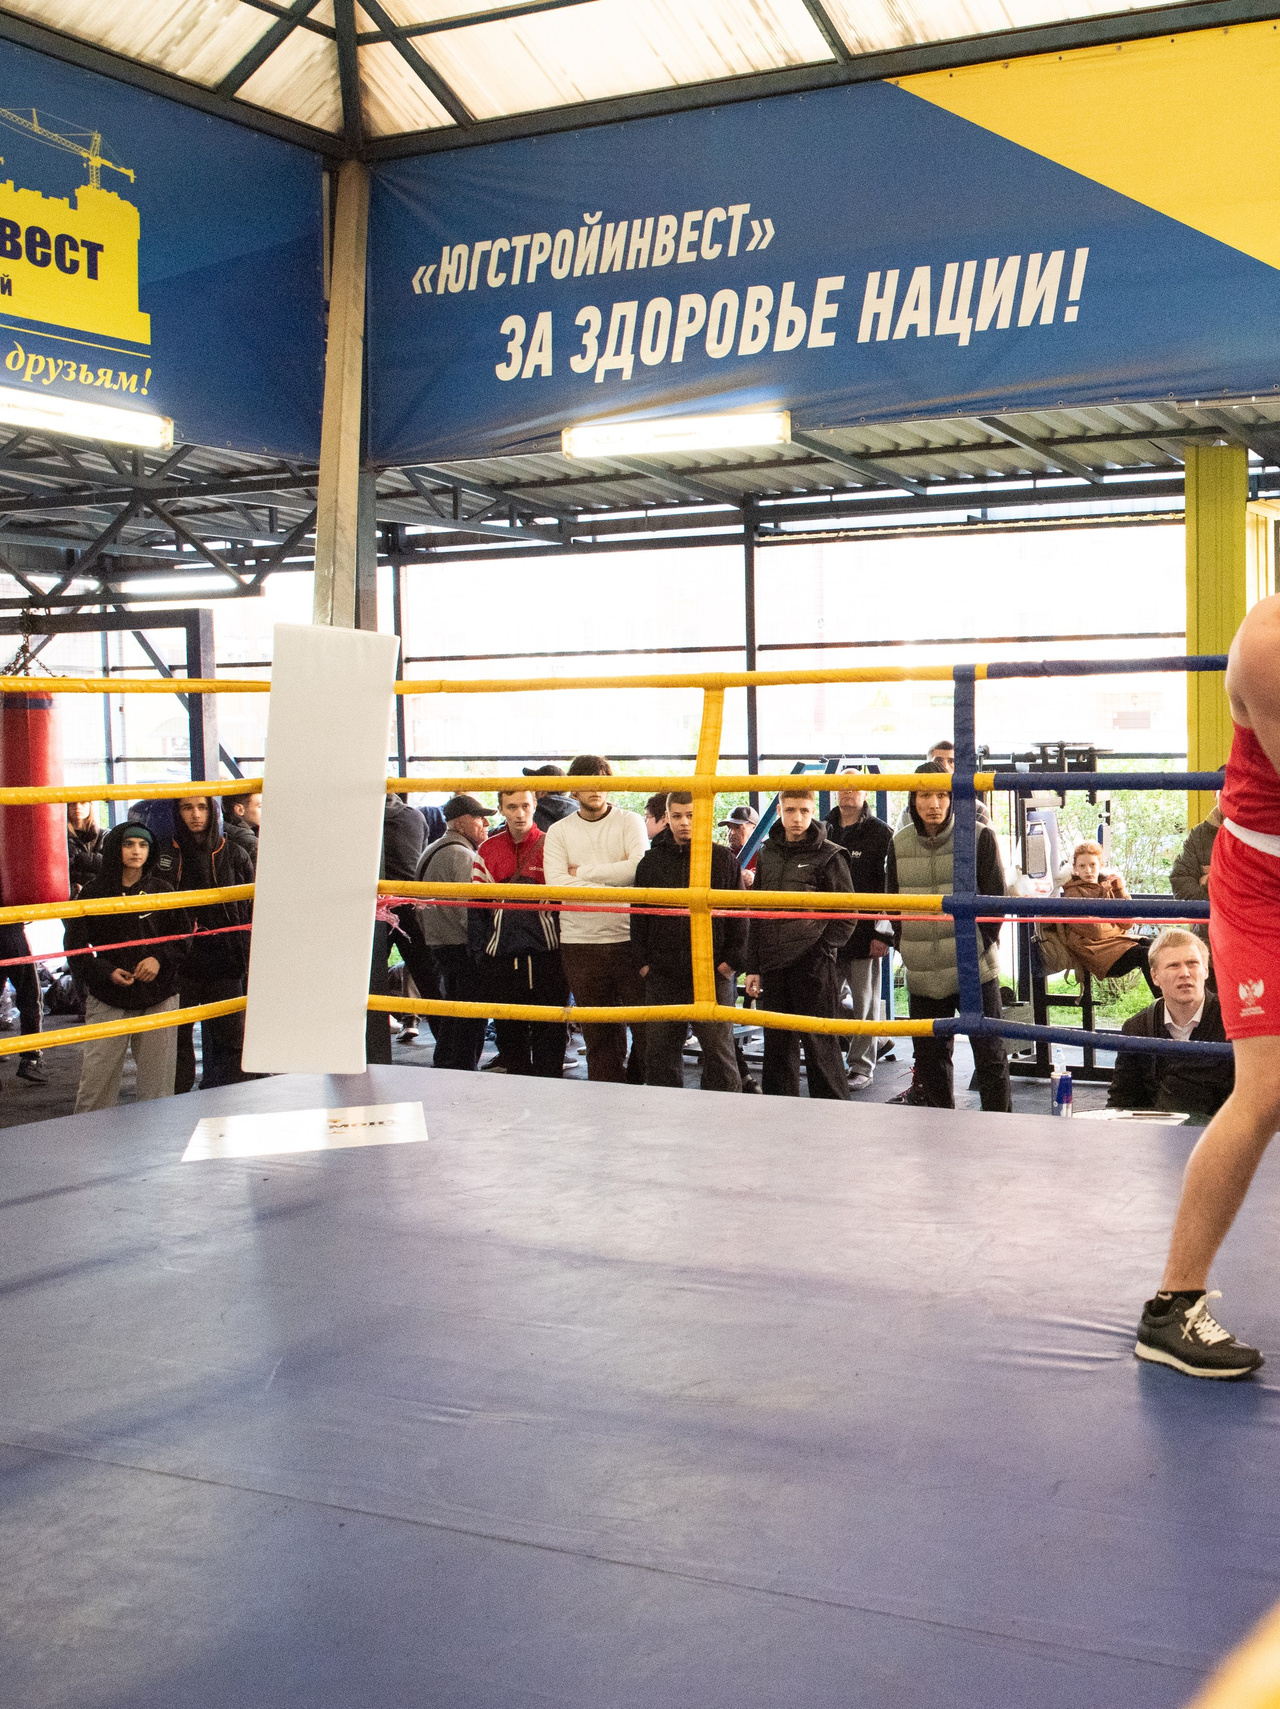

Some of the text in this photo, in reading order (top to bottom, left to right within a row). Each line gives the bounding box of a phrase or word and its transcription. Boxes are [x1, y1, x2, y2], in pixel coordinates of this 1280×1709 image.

[412, 203, 775, 295] «ЮГСТРОЙИНВЕСТ»
[495, 247, 1090, 384] ЗА ЗДОРОВЬЕ НАЦИИ!
[5, 341, 152, 396] друзьям!
